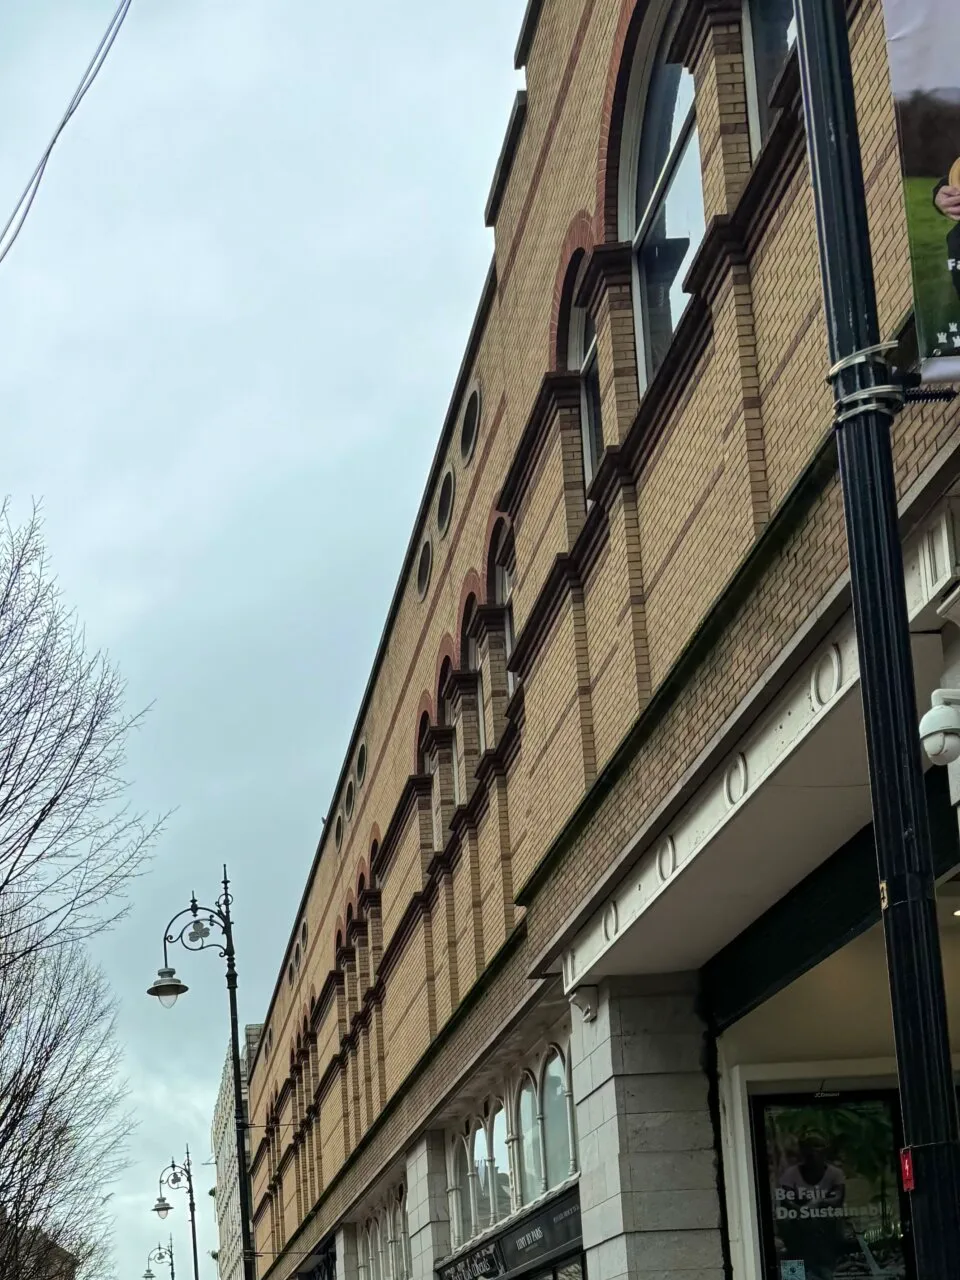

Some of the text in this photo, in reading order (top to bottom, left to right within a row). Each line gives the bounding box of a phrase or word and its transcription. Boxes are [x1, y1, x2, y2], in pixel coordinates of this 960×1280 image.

[775, 1188, 796, 1200] Be
[798, 1187, 826, 1200] Fair
[777, 1207, 797, 1220] Do
